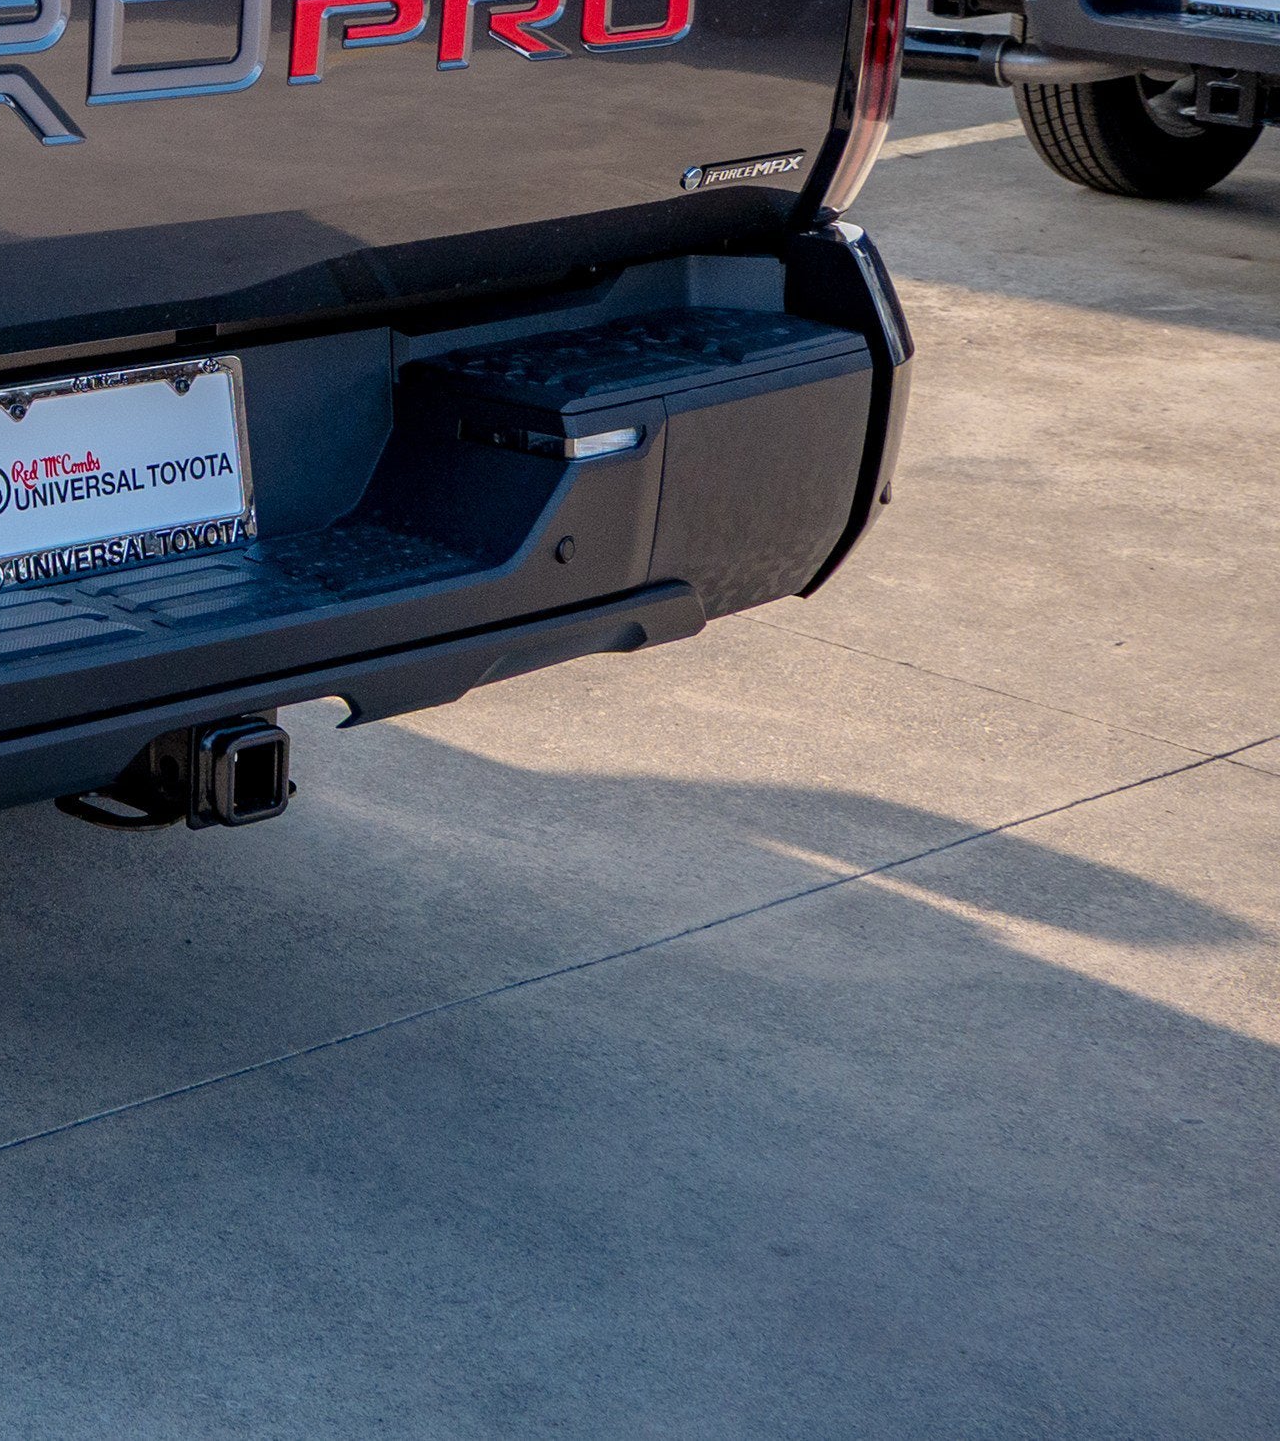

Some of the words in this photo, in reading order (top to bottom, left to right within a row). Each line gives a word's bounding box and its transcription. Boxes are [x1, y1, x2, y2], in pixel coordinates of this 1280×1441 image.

[11, 460, 39, 490] Red
[39, 450, 101, 478] McCombs
[13, 470, 145, 511] UNIVERSAL
[147, 452, 234, 488] TOYOTA
[13, 534, 155, 584] UNIVERSAL
[155, 518, 249, 556] TOYOTA
